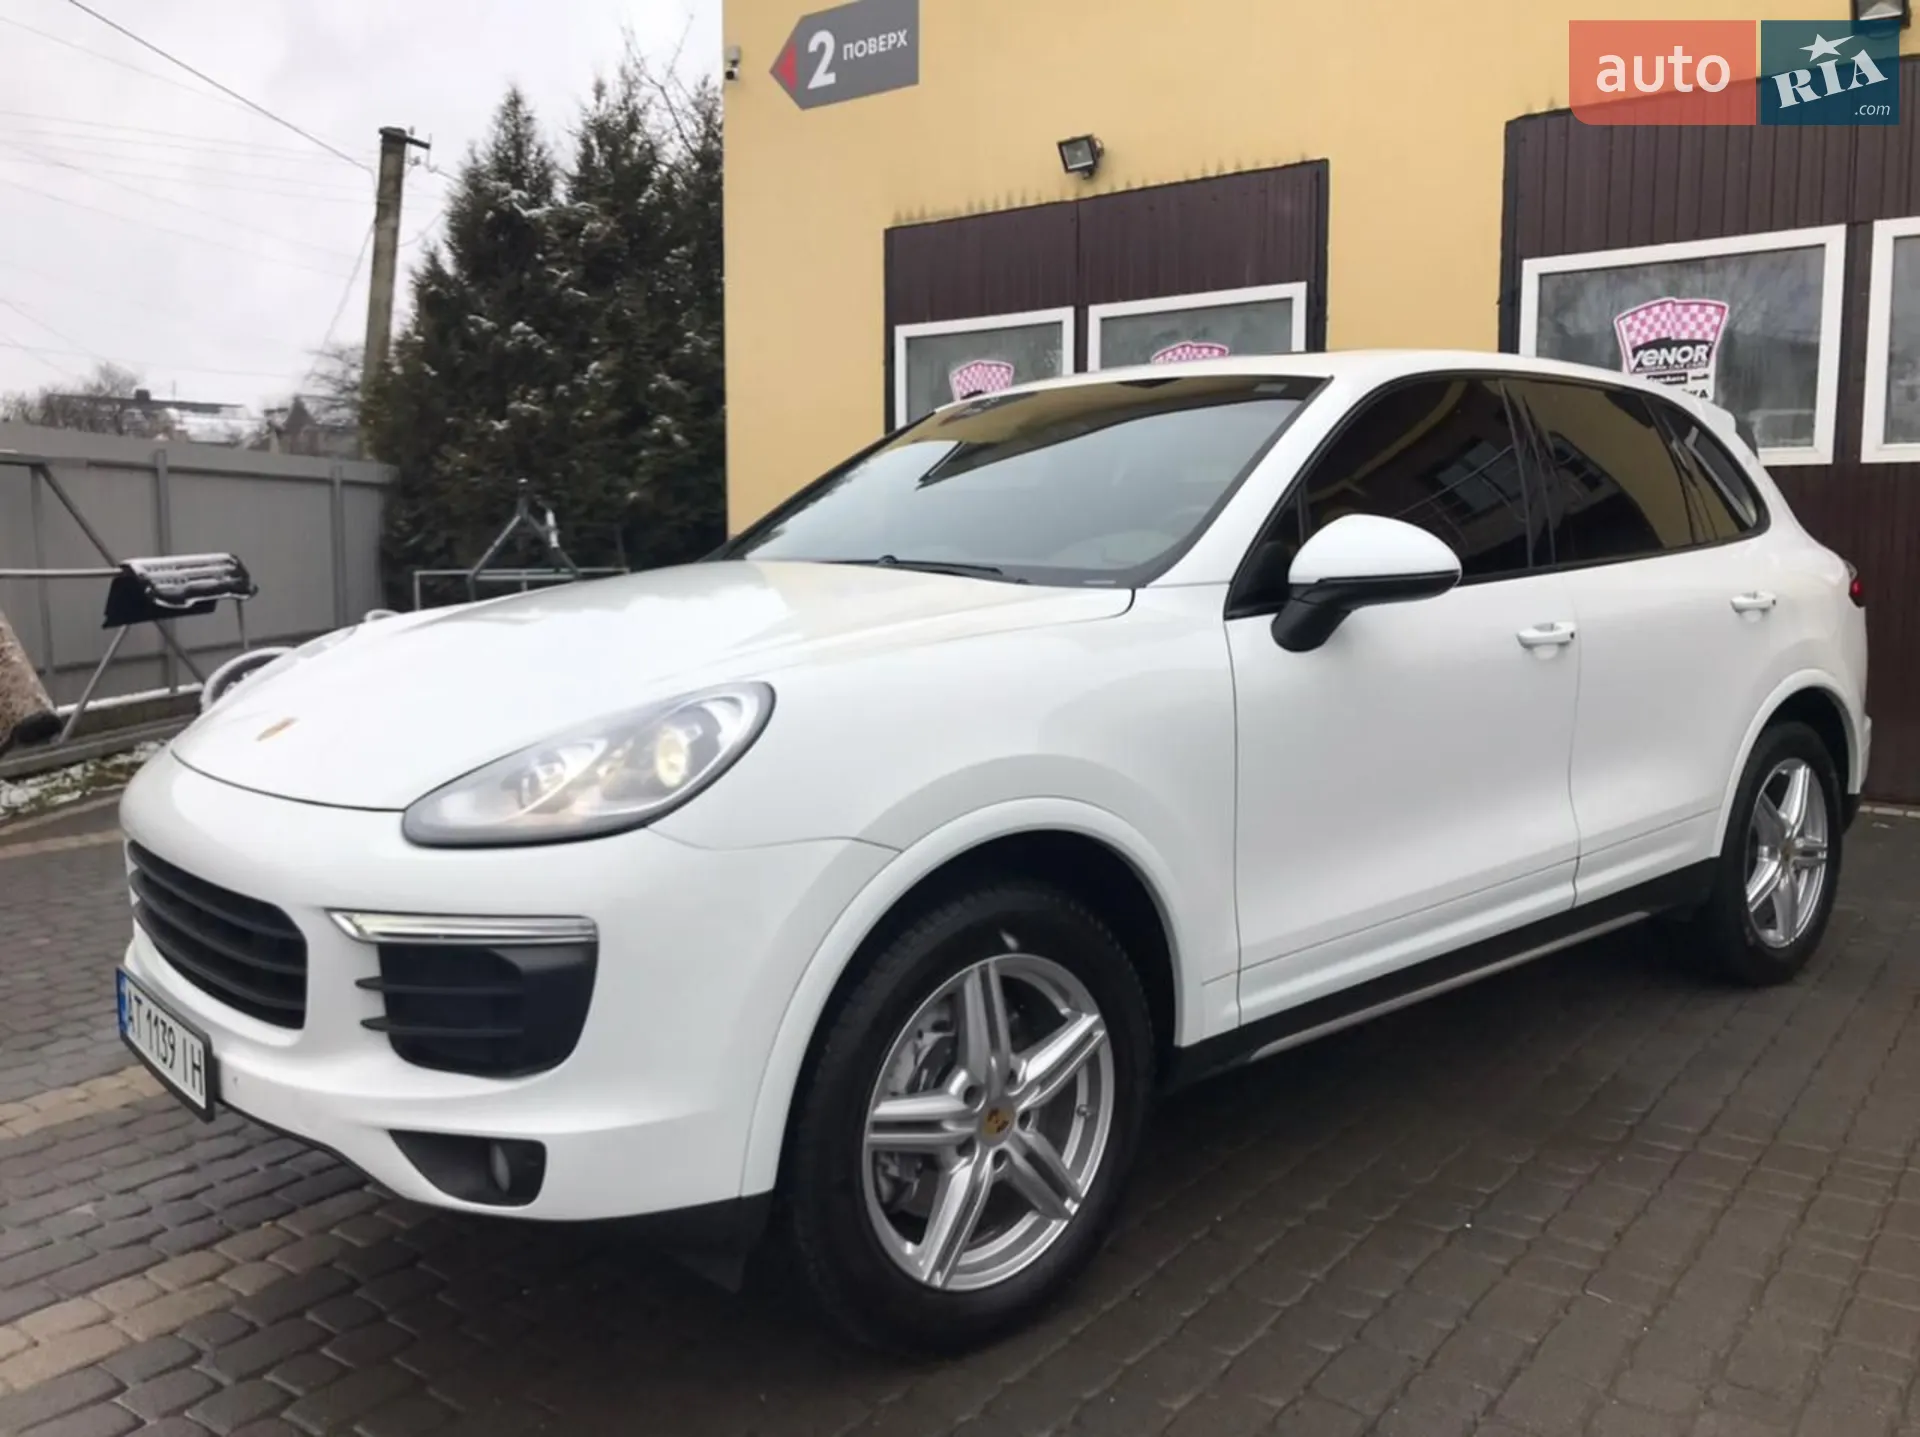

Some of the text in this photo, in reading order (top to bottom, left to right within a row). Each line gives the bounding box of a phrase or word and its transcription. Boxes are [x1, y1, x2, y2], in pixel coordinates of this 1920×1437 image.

[807, 29, 908, 90] 2 ПОВЕРХ
[128, 989, 204, 1097] AT 1139 IH
